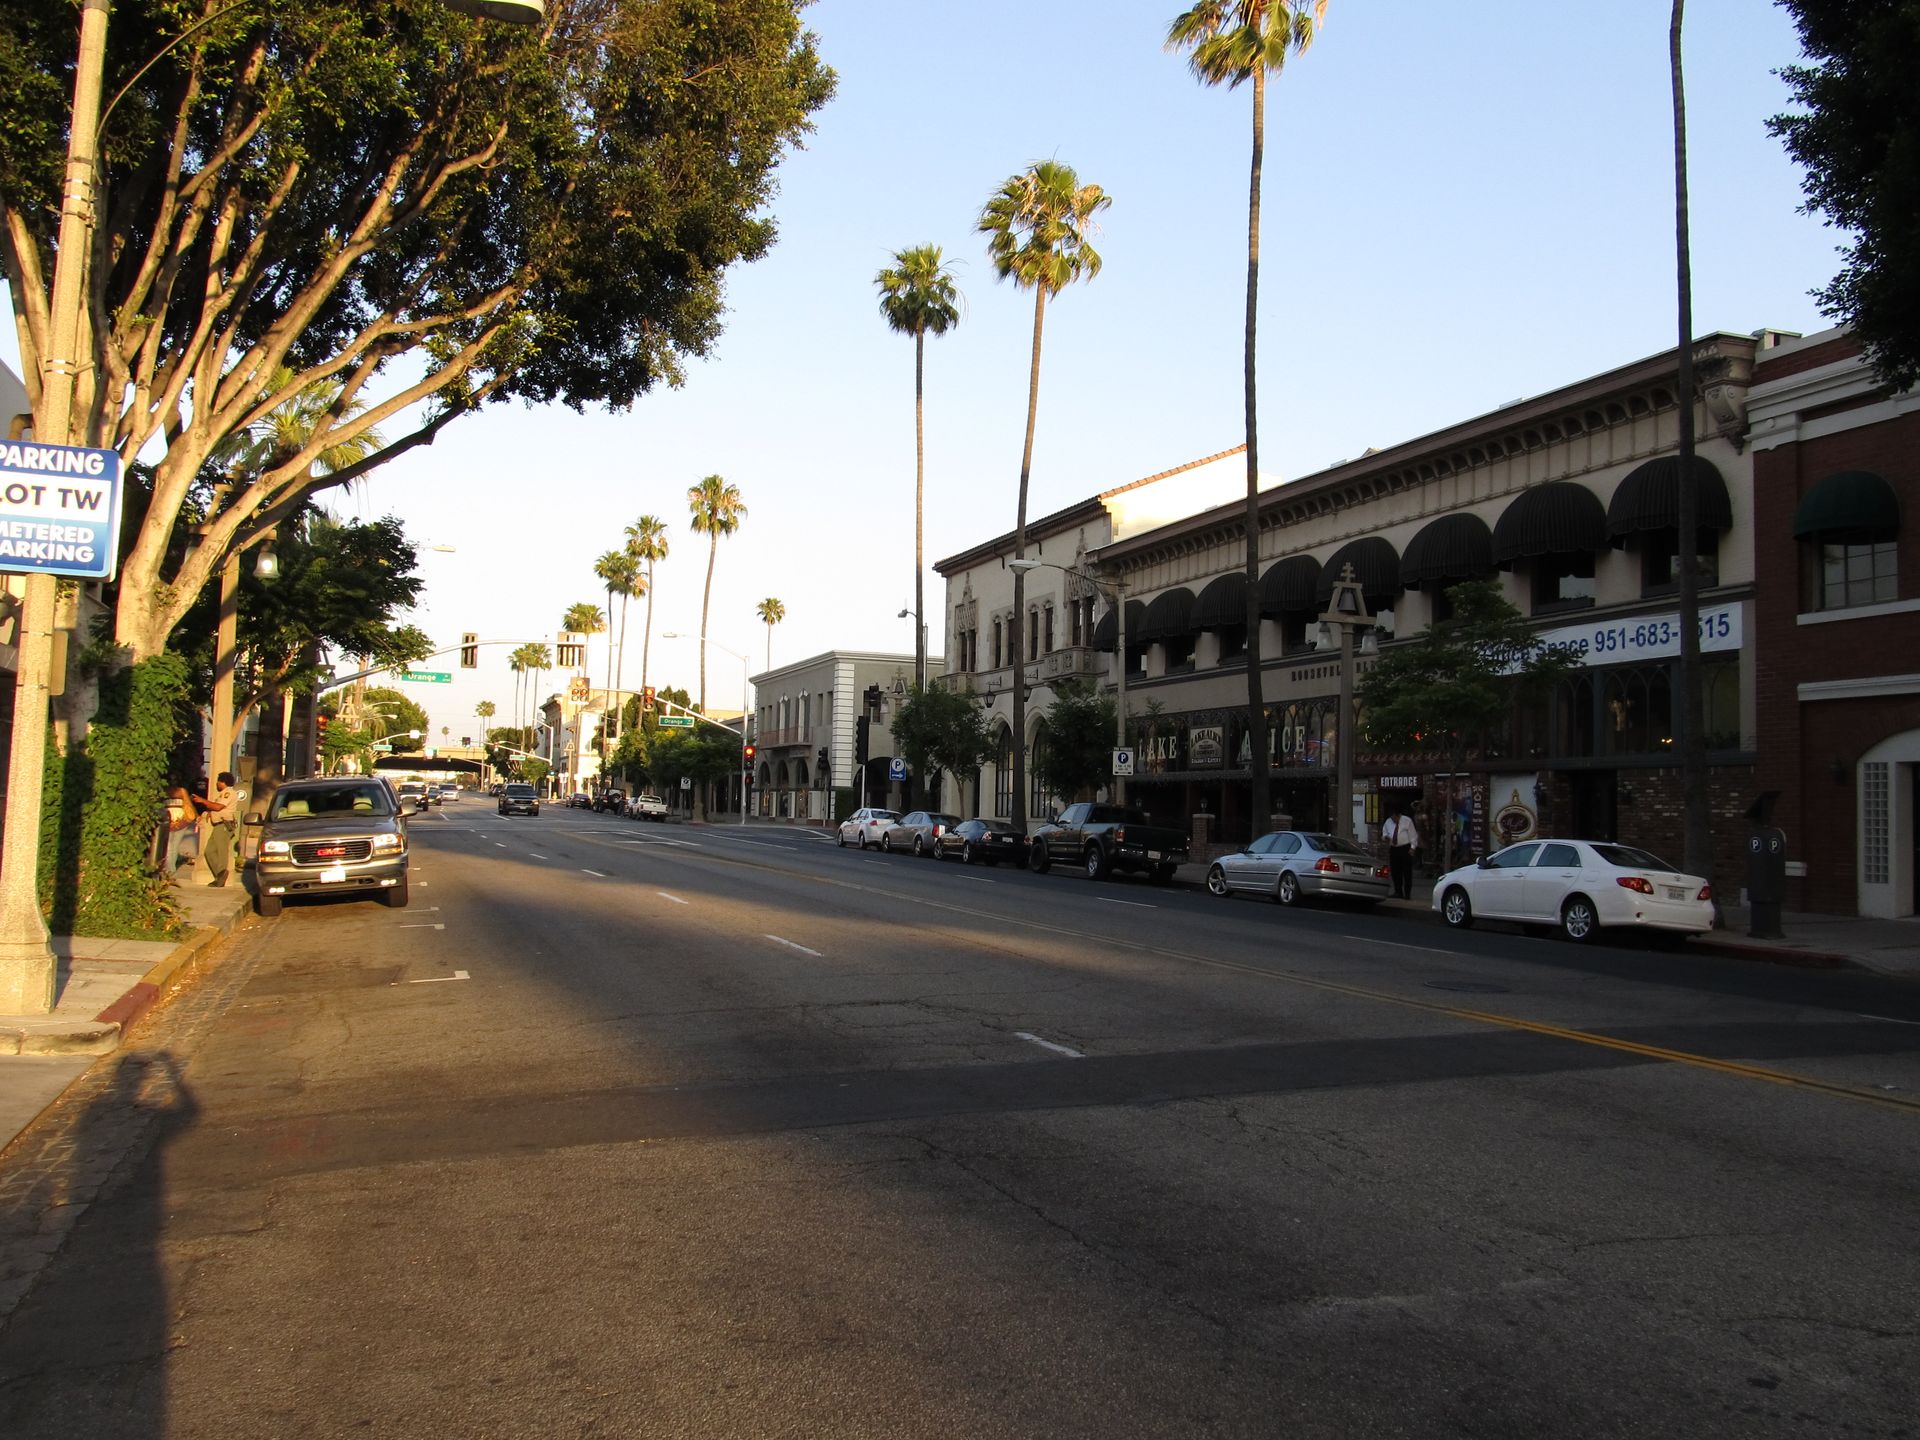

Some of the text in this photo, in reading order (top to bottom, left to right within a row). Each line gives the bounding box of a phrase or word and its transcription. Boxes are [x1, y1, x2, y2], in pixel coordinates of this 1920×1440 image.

[0, 483, 103, 510] OT TW
[0, 539, 95, 563] ARKING
[1594, 613, 1731, 653] 951-683-15
[407, 672, 436, 683] Orange
[1291, 664, 1343, 682] ROOSEVEL
[1138, 726, 1305, 762] LAKE AICE
[1380, 775, 1418, 788] ENTRANCE
[316, 847, 346, 857] GMC
